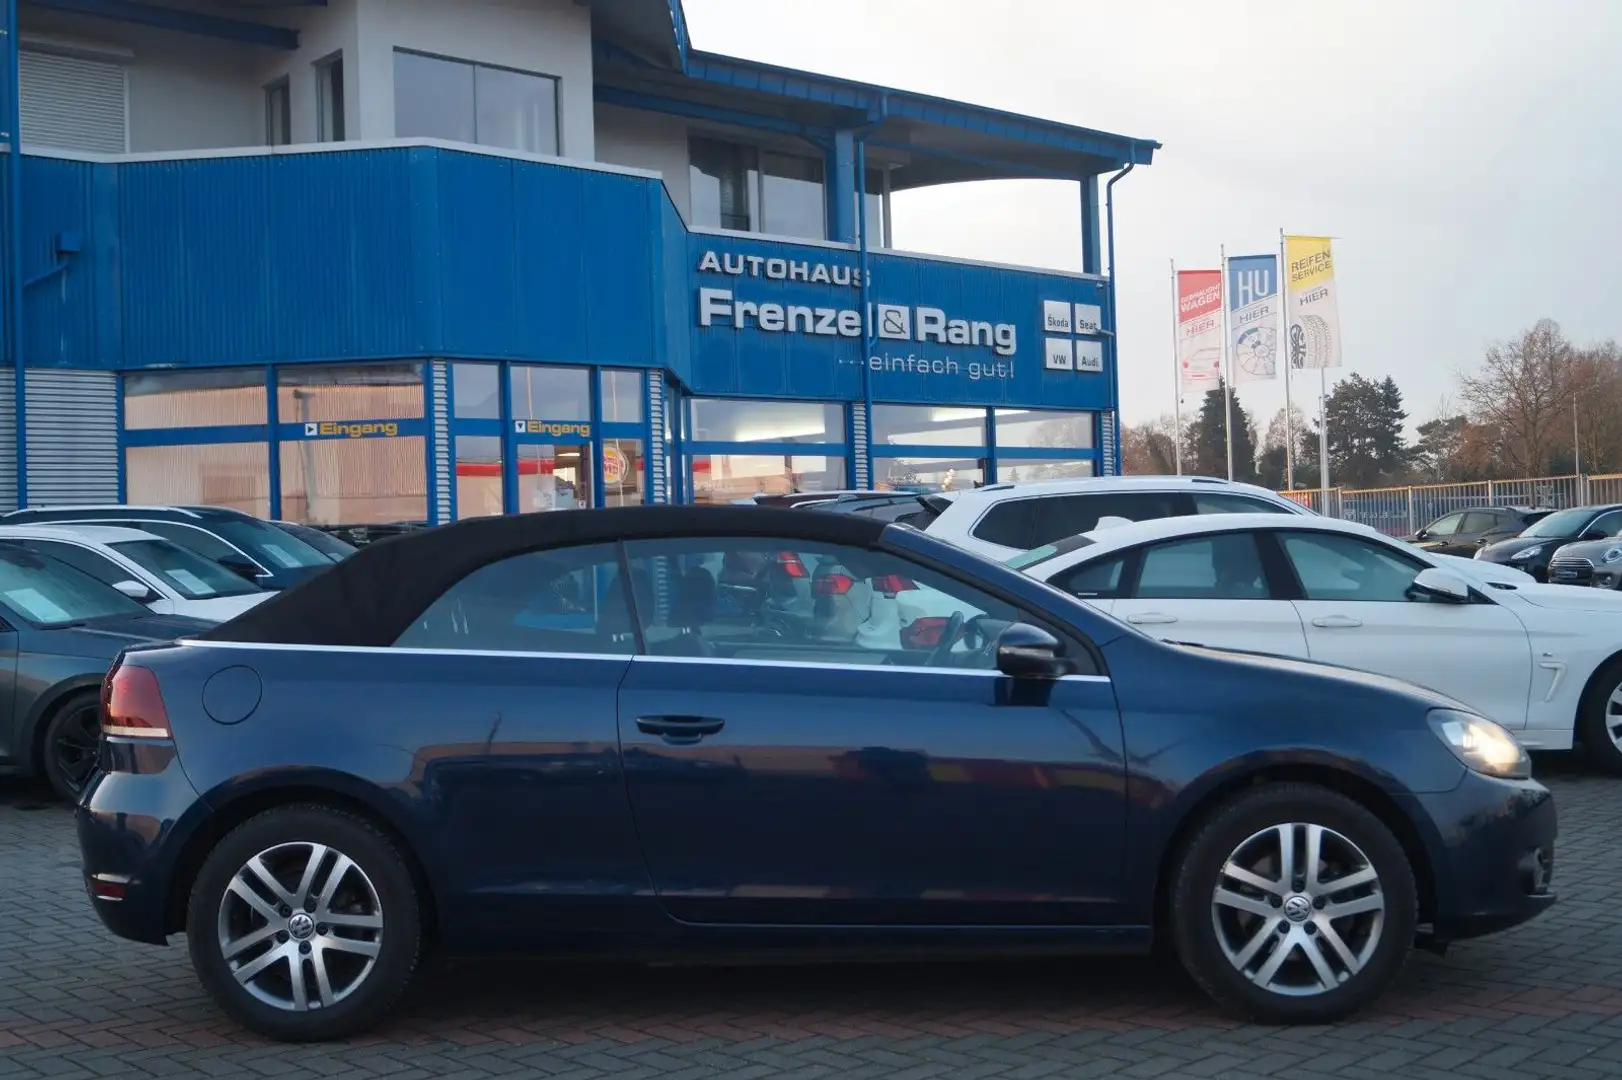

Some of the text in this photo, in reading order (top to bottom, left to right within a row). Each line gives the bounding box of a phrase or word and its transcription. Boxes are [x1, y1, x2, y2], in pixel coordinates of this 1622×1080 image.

[700, 251, 871, 288] AUTOHAUS
[1291, 249, 1331, 272] REIFEN
[1292, 260, 1332, 284] SERVICE
[1238, 269, 1269, 310] HU
[1300, 288, 1328, 306] HIER
[1181, 291, 1220, 313] WAGEN
[700, 287, 1017, 356] Frenzel & Rang
[1240, 306, 1269, 323] HIER
[1080, 318, 1097, 330] Seat
[1187, 319, 1215, 335] HIER
[1053, 354, 1067, 365] VW
[1082, 356, 1099, 367] Audi
[968, 361, 1014, 380] gut!
[320, 420, 398, 438] Eingang
[527, 420, 590, 437] Eingang
